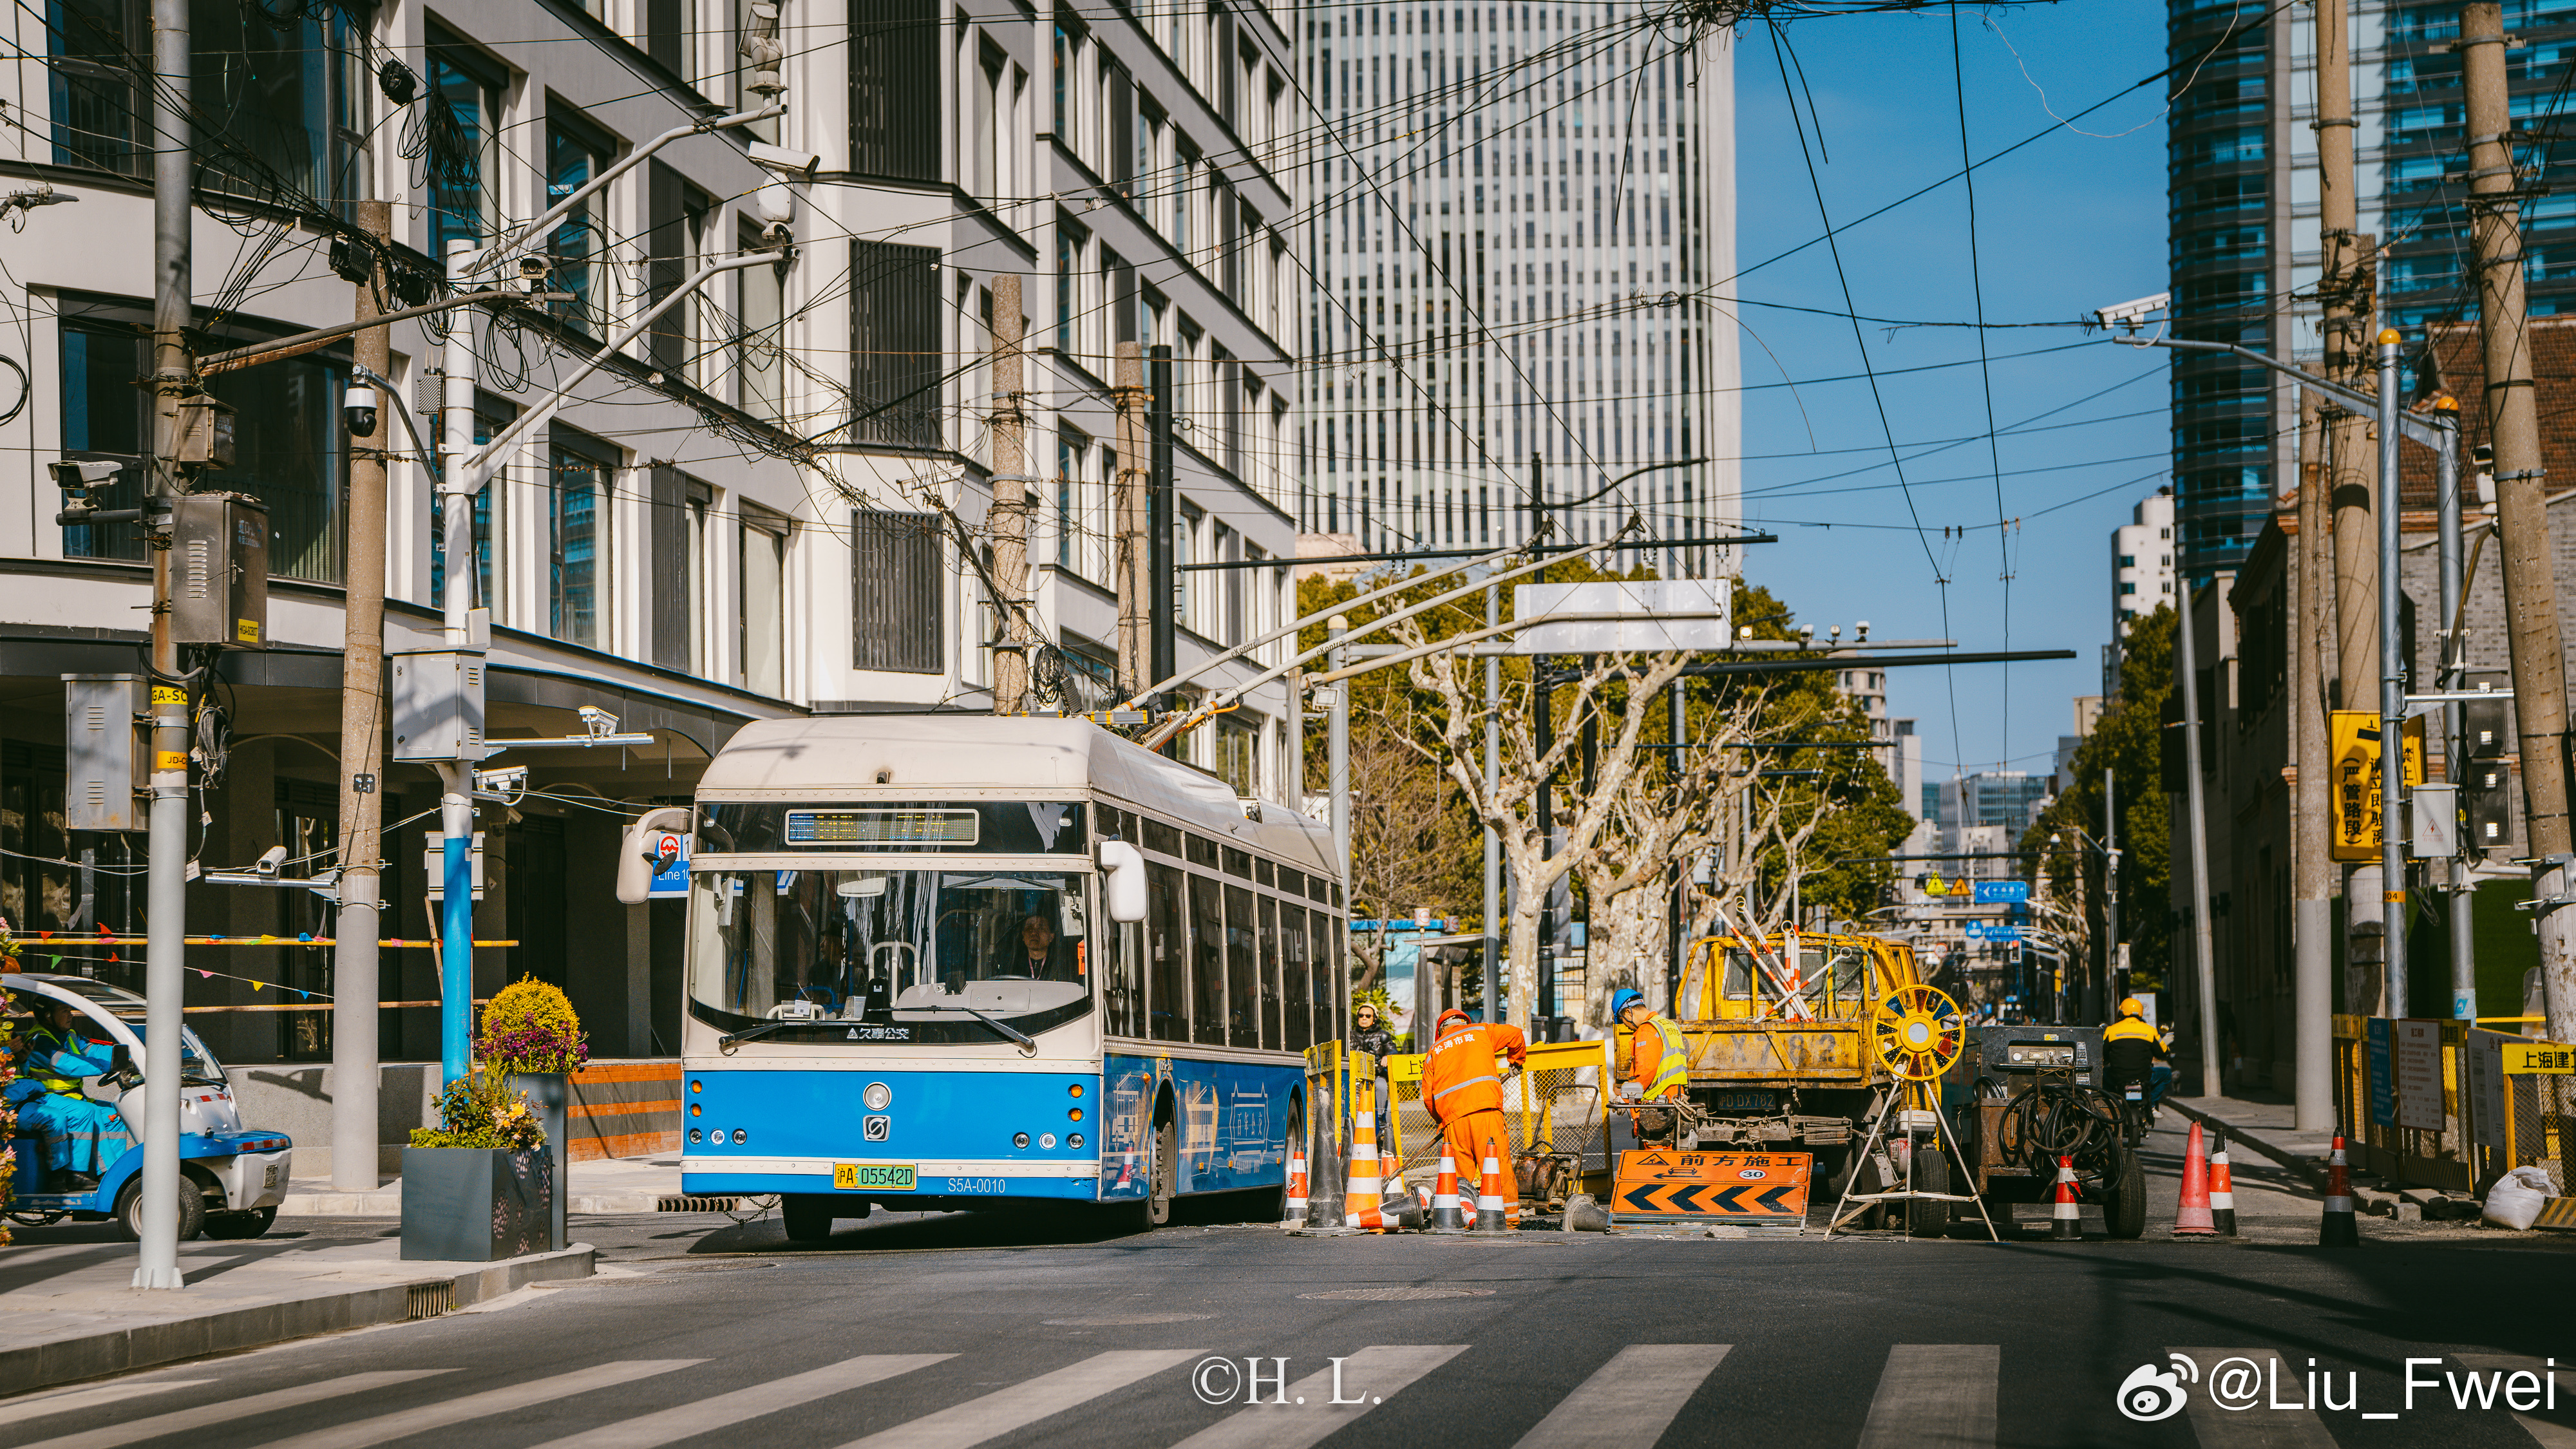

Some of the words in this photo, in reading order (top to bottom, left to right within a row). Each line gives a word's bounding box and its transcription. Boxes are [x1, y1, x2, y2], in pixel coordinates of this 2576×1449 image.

[152, 688, 188, 702] GA-SC
[1434, 1033, 1475, 1055] 松涛市政
[1680, 1154, 1803, 1167] 前方施工
[861, 1168, 913, 1184] 05542D
[948, 1178, 1005, 1193] S5A-0010
